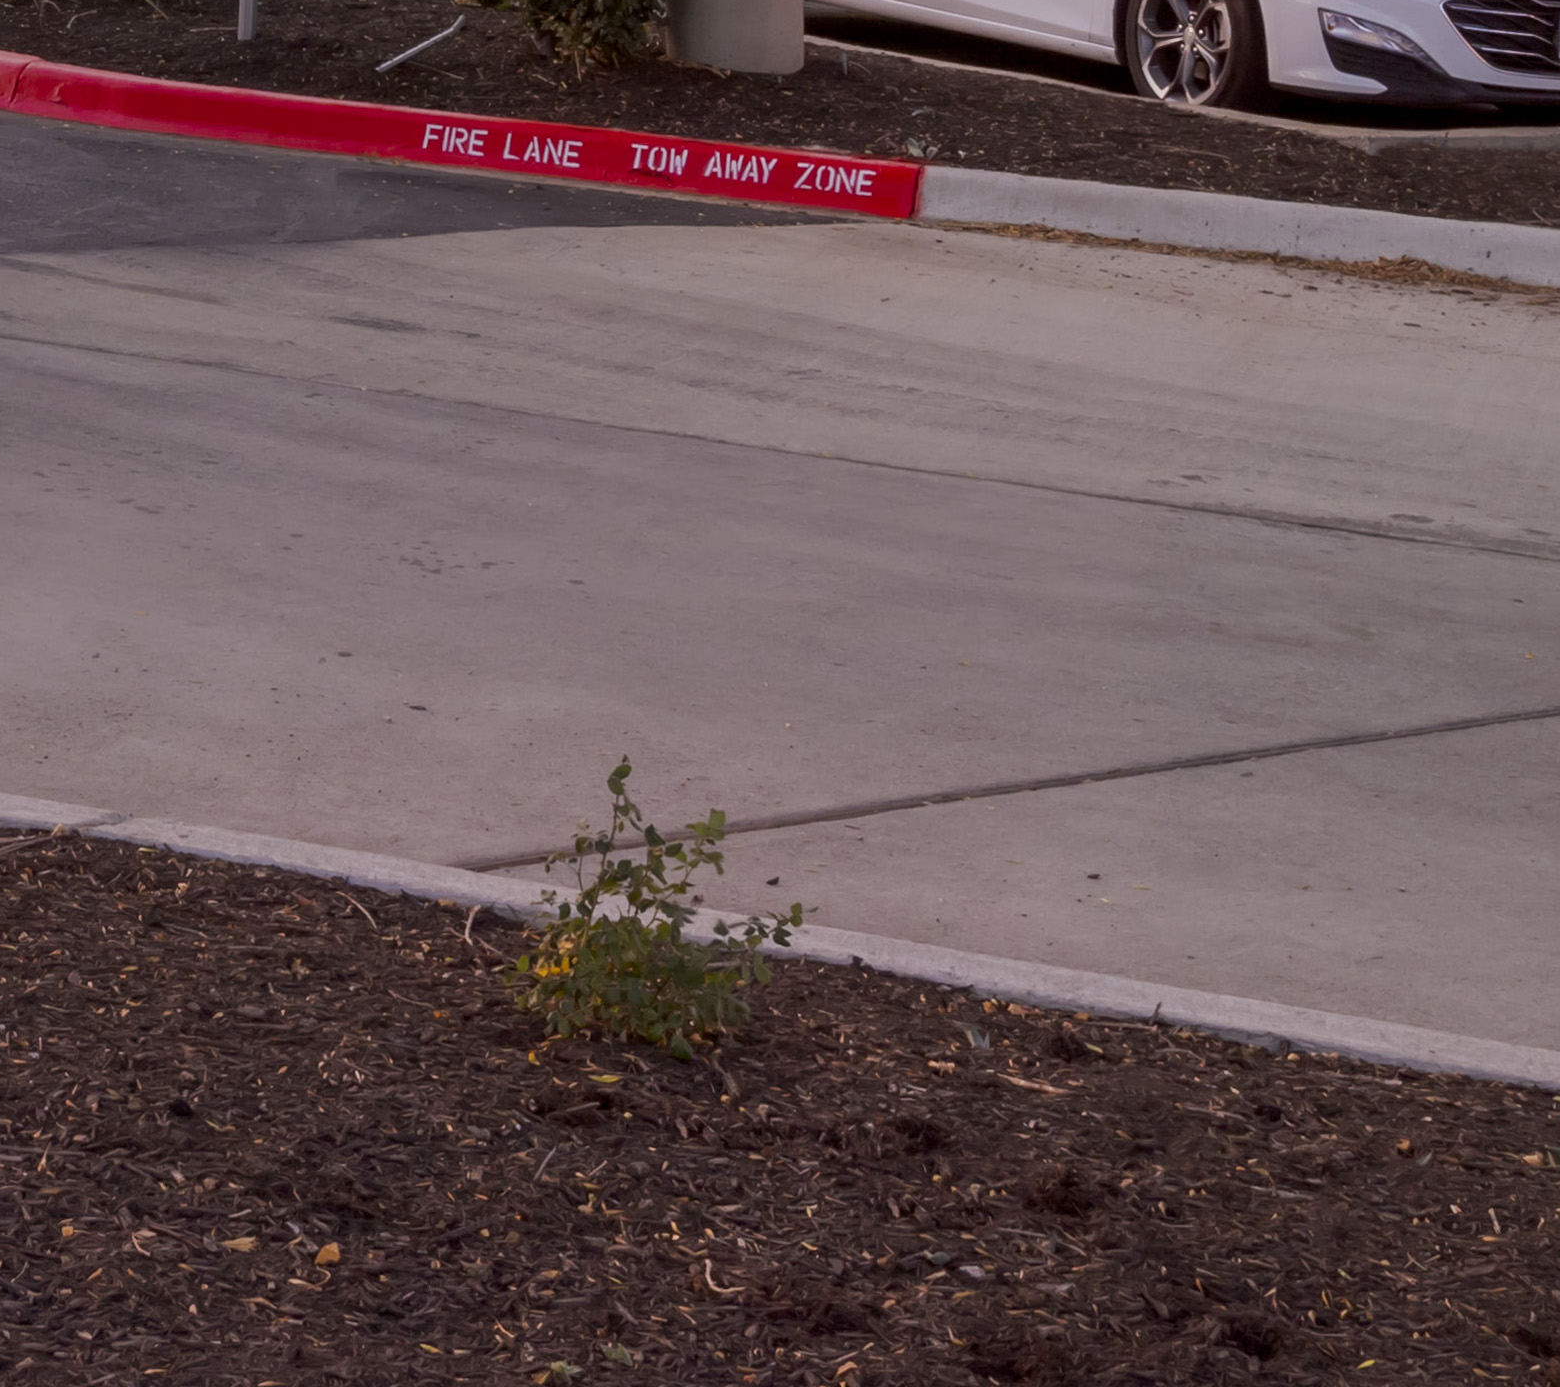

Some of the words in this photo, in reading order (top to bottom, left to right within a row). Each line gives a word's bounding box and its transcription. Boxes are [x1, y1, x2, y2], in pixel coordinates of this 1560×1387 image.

[422, 123, 489, 157] FIRE
[502, 132, 583, 169] LANE
[631, 143, 688, 176] TOW
[704, 151, 778, 184] AWAY
[793, 162, 878, 197] ZONE
